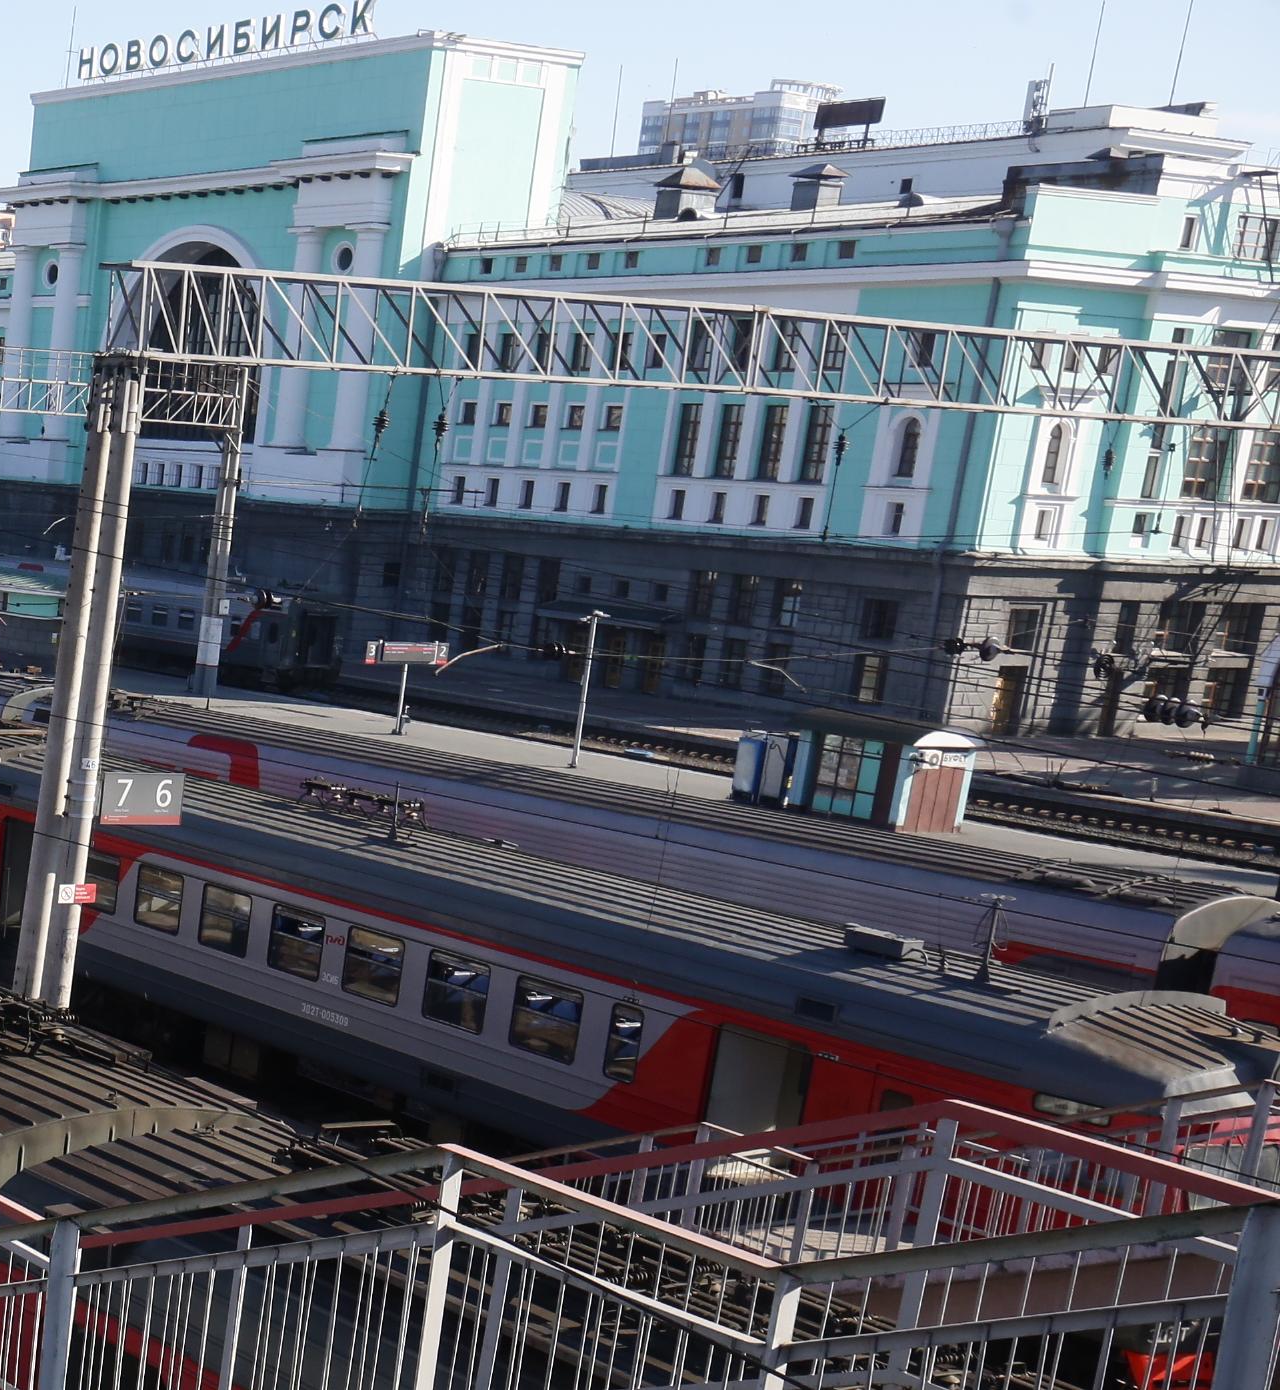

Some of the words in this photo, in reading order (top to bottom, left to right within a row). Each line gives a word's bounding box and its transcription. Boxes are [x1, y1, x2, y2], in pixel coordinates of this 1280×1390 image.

[77, 0, 376, 79] НОВОСИБИРСК
[368, 644, 376, 657] 3
[439, 646, 447, 657] 2
[943, 753, 968, 763] БУФЕТ
[117, 778, 134, 807] 7
[156, 778, 173, 808] 6
